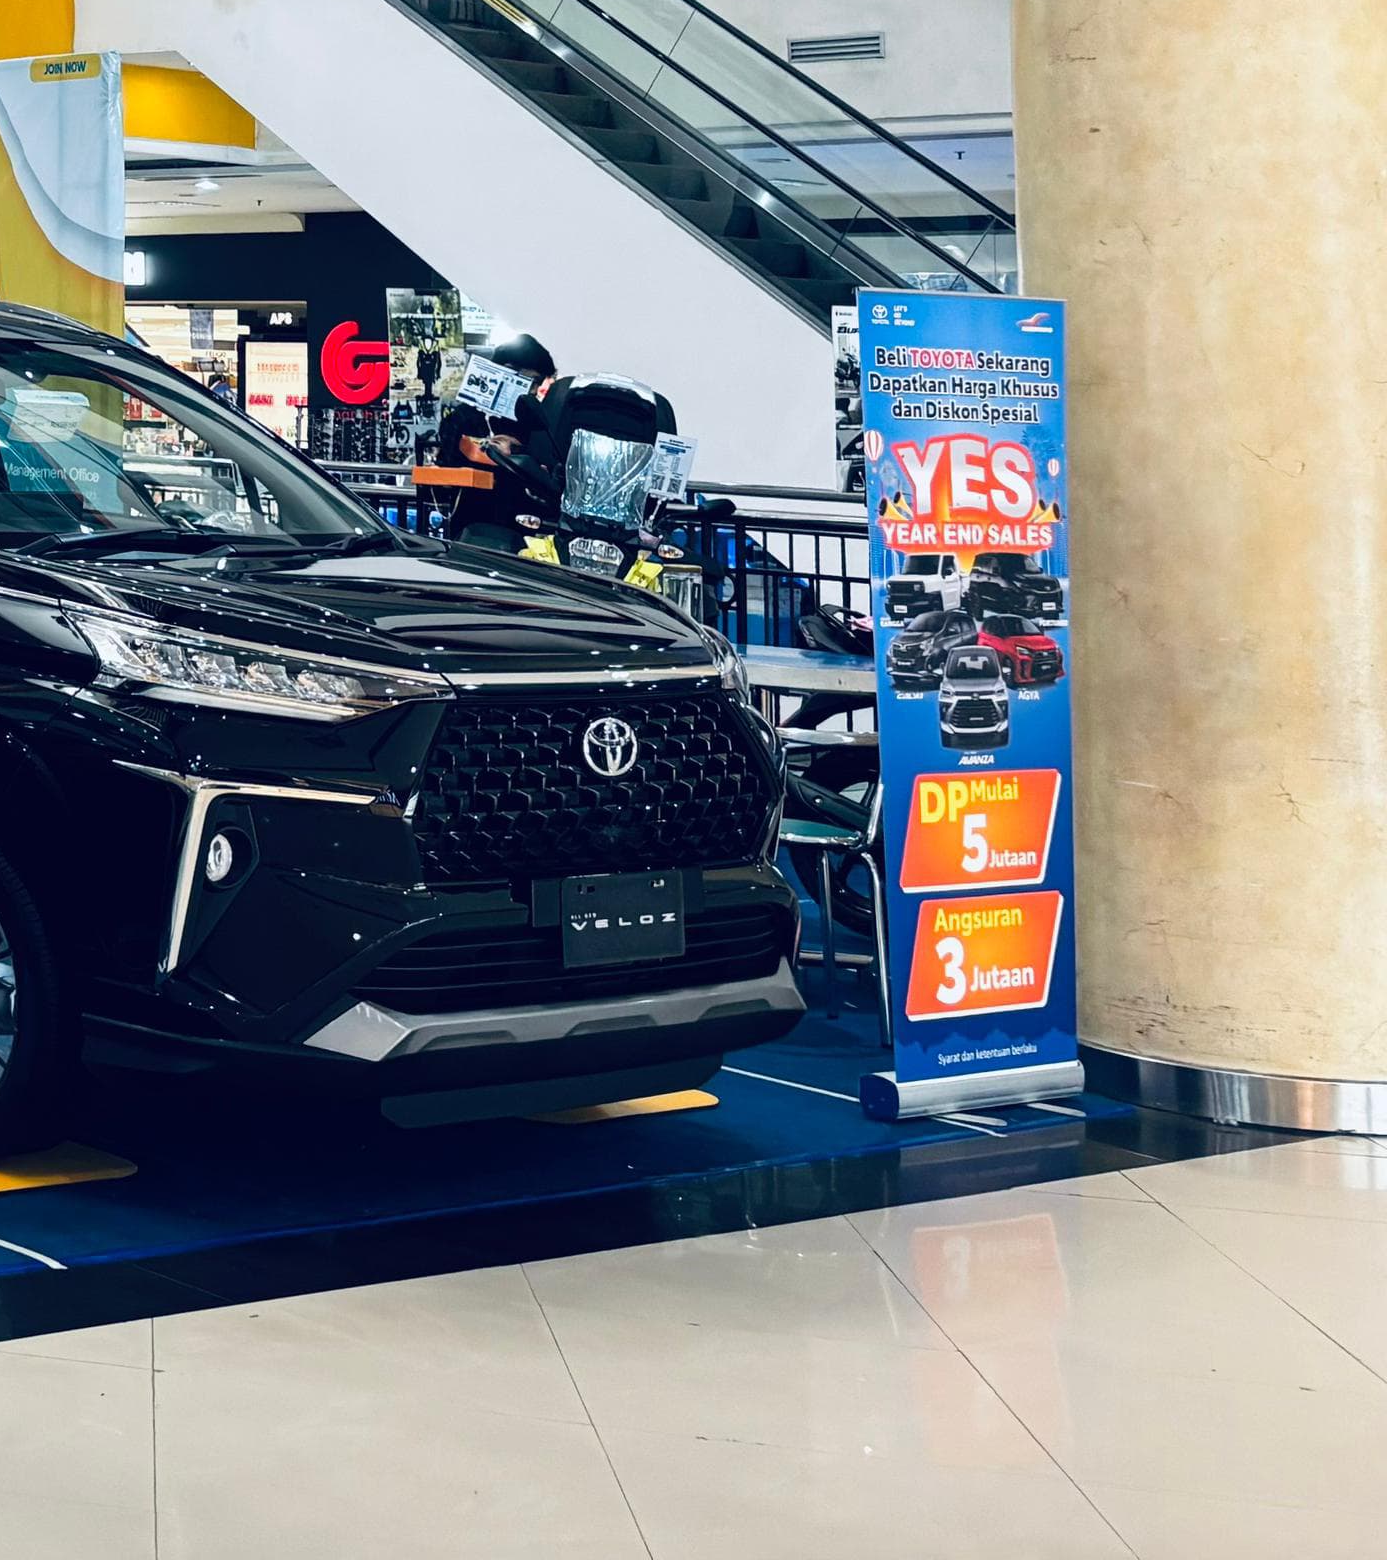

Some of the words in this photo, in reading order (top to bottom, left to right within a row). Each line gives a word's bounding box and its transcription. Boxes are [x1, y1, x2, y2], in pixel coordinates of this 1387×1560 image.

[44, 62, 61, 75] JOIN
[64, 60, 87, 74] NOW
[875, 347, 907, 367] Beli
[910, 349, 975, 369] TOYOTA
[977, 352, 1051, 377] Sekarang
[869, 374, 947, 396] Dapatkan
[951, 377, 997, 400] Harga
[1001, 378, 1059, 399] Khusus
[892, 400, 922, 419] dan
[926, 401, 979, 421] Diskon
[981, 402, 1040, 425] Spesial
[68, 467, 99, 483] Office
[897, 438, 1034, 520] YES
[883, 522, 937, 545] YEAR
[944, 523, 984, 545] END
[987, 524, 1052, 547] SALES
[958, 755, 994, 765] AVANZA
[918, 781, 968, 824] DP
[970, 776, 1019, 802] Mulai
[961, 813, 988, 873] 5
[987, 849, 1037, 869] Jutaan
[571, 912, 676, 931] VELOZ
[934, 907, 1023, 937] Angsuran
[935, 936, 967, 1005] 3
[969, 964, 1035, 993] Jutaan
[938, 1053, 961, 1067] Syarat
[961, 1050, 975, 1061] dan
[975, 1047, 1011, 1060] ketentuan
